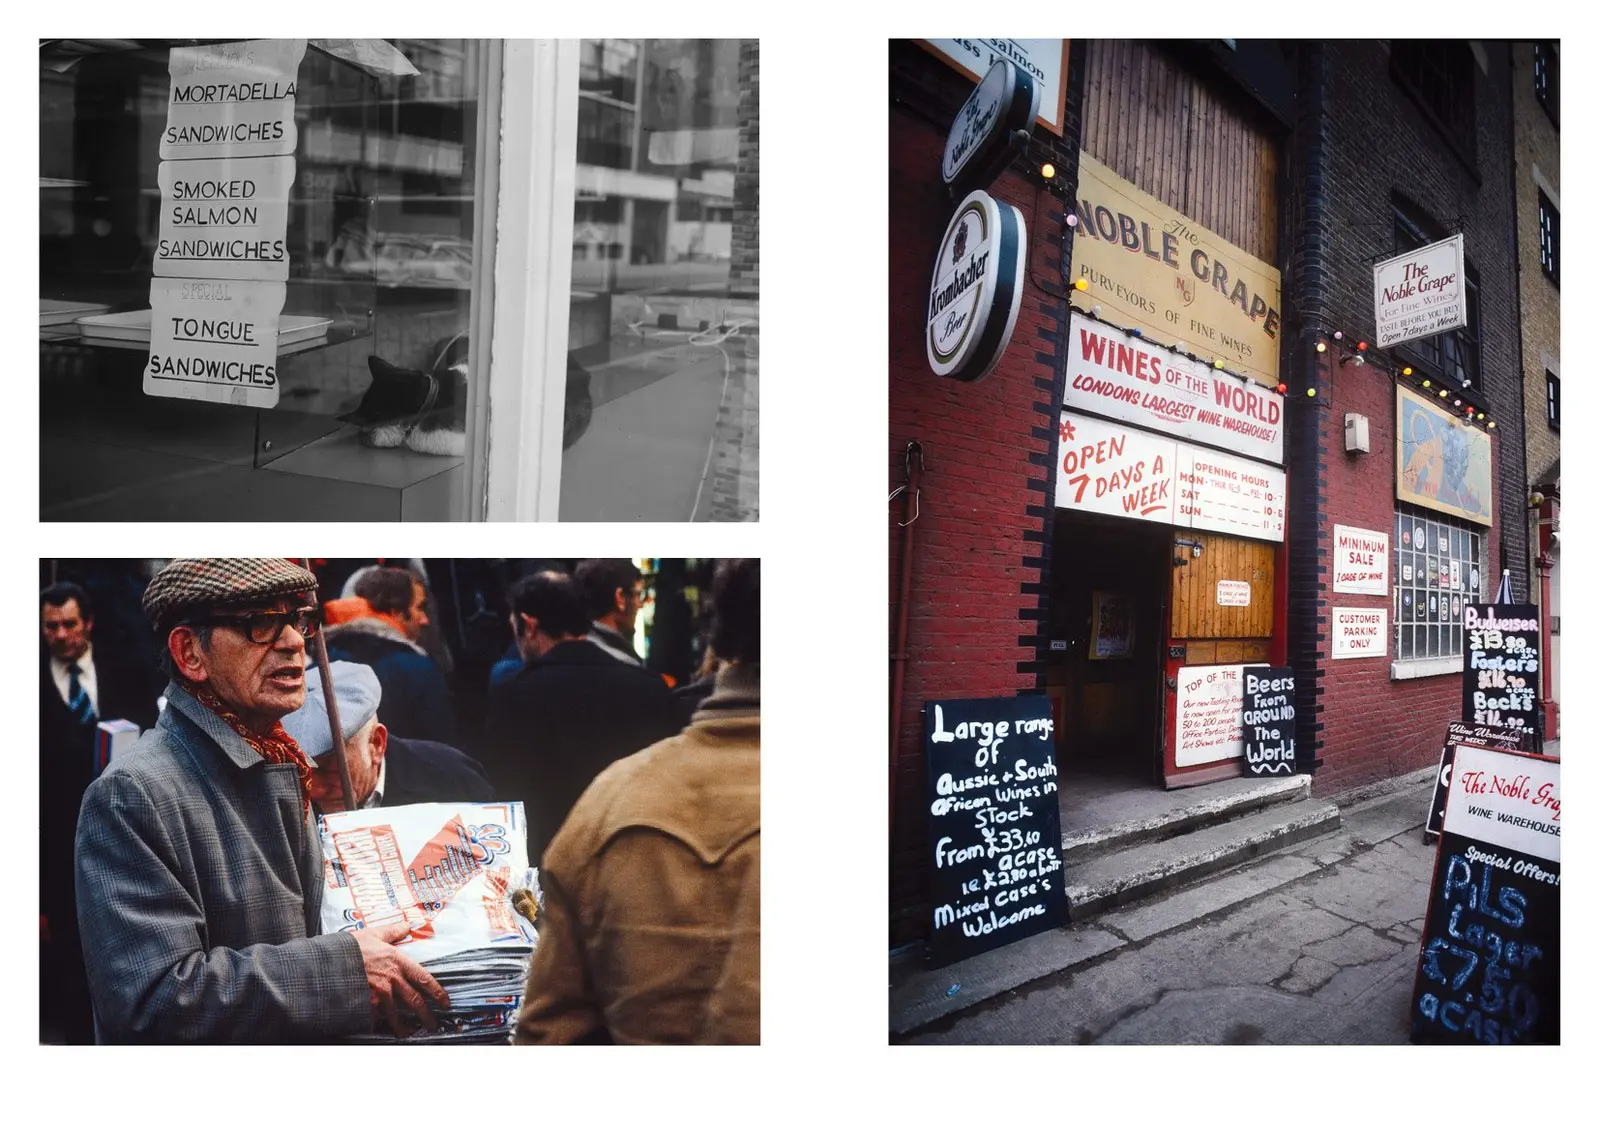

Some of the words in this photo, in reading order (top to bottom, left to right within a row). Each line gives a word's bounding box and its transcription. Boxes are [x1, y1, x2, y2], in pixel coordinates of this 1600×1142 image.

[174, 82, 296, 102] MORTADELLA
[167, 121, 284, 143] SANDWICHES
[172, 181, 256, 199] SMOKED
[172, 207, 257, 225] SALMON
[1164, 220, 1200, 245] The
[159, 240, 284, 259] SANDWICHES
[1074, 200, 1180, 270] NOBLE
[1190, 248, 1280, 340] GRAPE
[1402, 261, 1428, 282] The
[182, 283, 232, 299] SPECIAL
[930, 250, 989, 321] Krombacher
[1380, 282, 1416, 306] Noble
[1418, 272, 1456, 292] Grape
[1080, 264, 1156, 314] PURVEYORS
[1165, 310, 1180, 324] OF
[1190, 320, 1216, 340] FINE
[1220, 332, 1252, 357] WINES
[1384, 307, 1398, 318] For
[1401, 301, 1420, 313] Fine
[1423, 292, 1454, 304] Wines
[172, 318, 254, 342] TONGUE
[940, 310, 967, 342] Beer
[1380, 322, 1398, 334] TASTE
[1400, 314, 1426, 328] BEFORE
[1427, 309, 1442, 320] YOU
[1444, 303, 1460, 314] BUY
[1381, 332, 1401, 344] Open
[1436, 314, 1459, 328] Week
[150, 355, 276, 386] SANDWICHES
[1080, 328, 1162, 384] WINES
[1166, 368, 1182, 385] OF
[1187, 376, 1208, 395] THE
[1214, 379, 1280, 426] WORLD
[1072, 374, 1141, 406] LONDONS
[1142, 393, 1196, 422] LARGEST
[1197, 408, 1222, 427] WINE
[1222, 416, 1277, 444] WAREHOUSE!
[1063, 434, 1126, 475] OPEN
[1068, 474, 1091, 504] 7
[1095, 461, 1145, 498] DAYS
[1152, 454, 1164, 476] A
[1194, 462, 1238, 480] OPENING
[1242, 474, 1270, 488] HOURS
[1122, 478, 1170, 514] WEEK
[1182, 489, 1200, 500] SAT
[1180, 505, 1201, 516] SUN
[1339, 536, 1385, 554] MINIMUM
[1349, 552, 1374, 566] SALE
[1368, 572, 1383, 581] WINE
[1339, 614, 1380, 624] CUSTOMER
[1344, 627, 1378, 636] PARKING
[1350, 639, 1371, 648] ONLY
[1185, 678, 1202, 694] TOP
[1206, 672, 1218, 684] OF
[1222, 670, 1237, 680] THE
[1246, 674, 1294, 694] Beers
[1184, 700, 1196, 709] Our
[931, 705, 1010, 746] Large
[1015, 718, 1054, 740] range
[1182, 720, 1192, 730] 50
[1202, 717, 1217, 728] 200
[1182, 730, 1202, 740] Office
[1254, 726, 1280, 740] The
[1246, 738, 1294, 763] World
[1015, 755, 1058, 782] South
[1044, 778, 1058, 794] in
[1462, 772, 1486, 794] The
[1489, 775, 1530, 800] Noble
[1468, 805, 1494, 820] WINE
[1498, 812, 1560, 836] WAREHOUSE
[1014, 847, 1056, 868] case
[1464, 846, 1510, 870] Special
[1513, 860, 1560, 886] Offers!
[934, 896, 990, 930] Mixed
[962, 904, 1046, 937] Welcome
[1448, 902, 1543, 965] Lager
